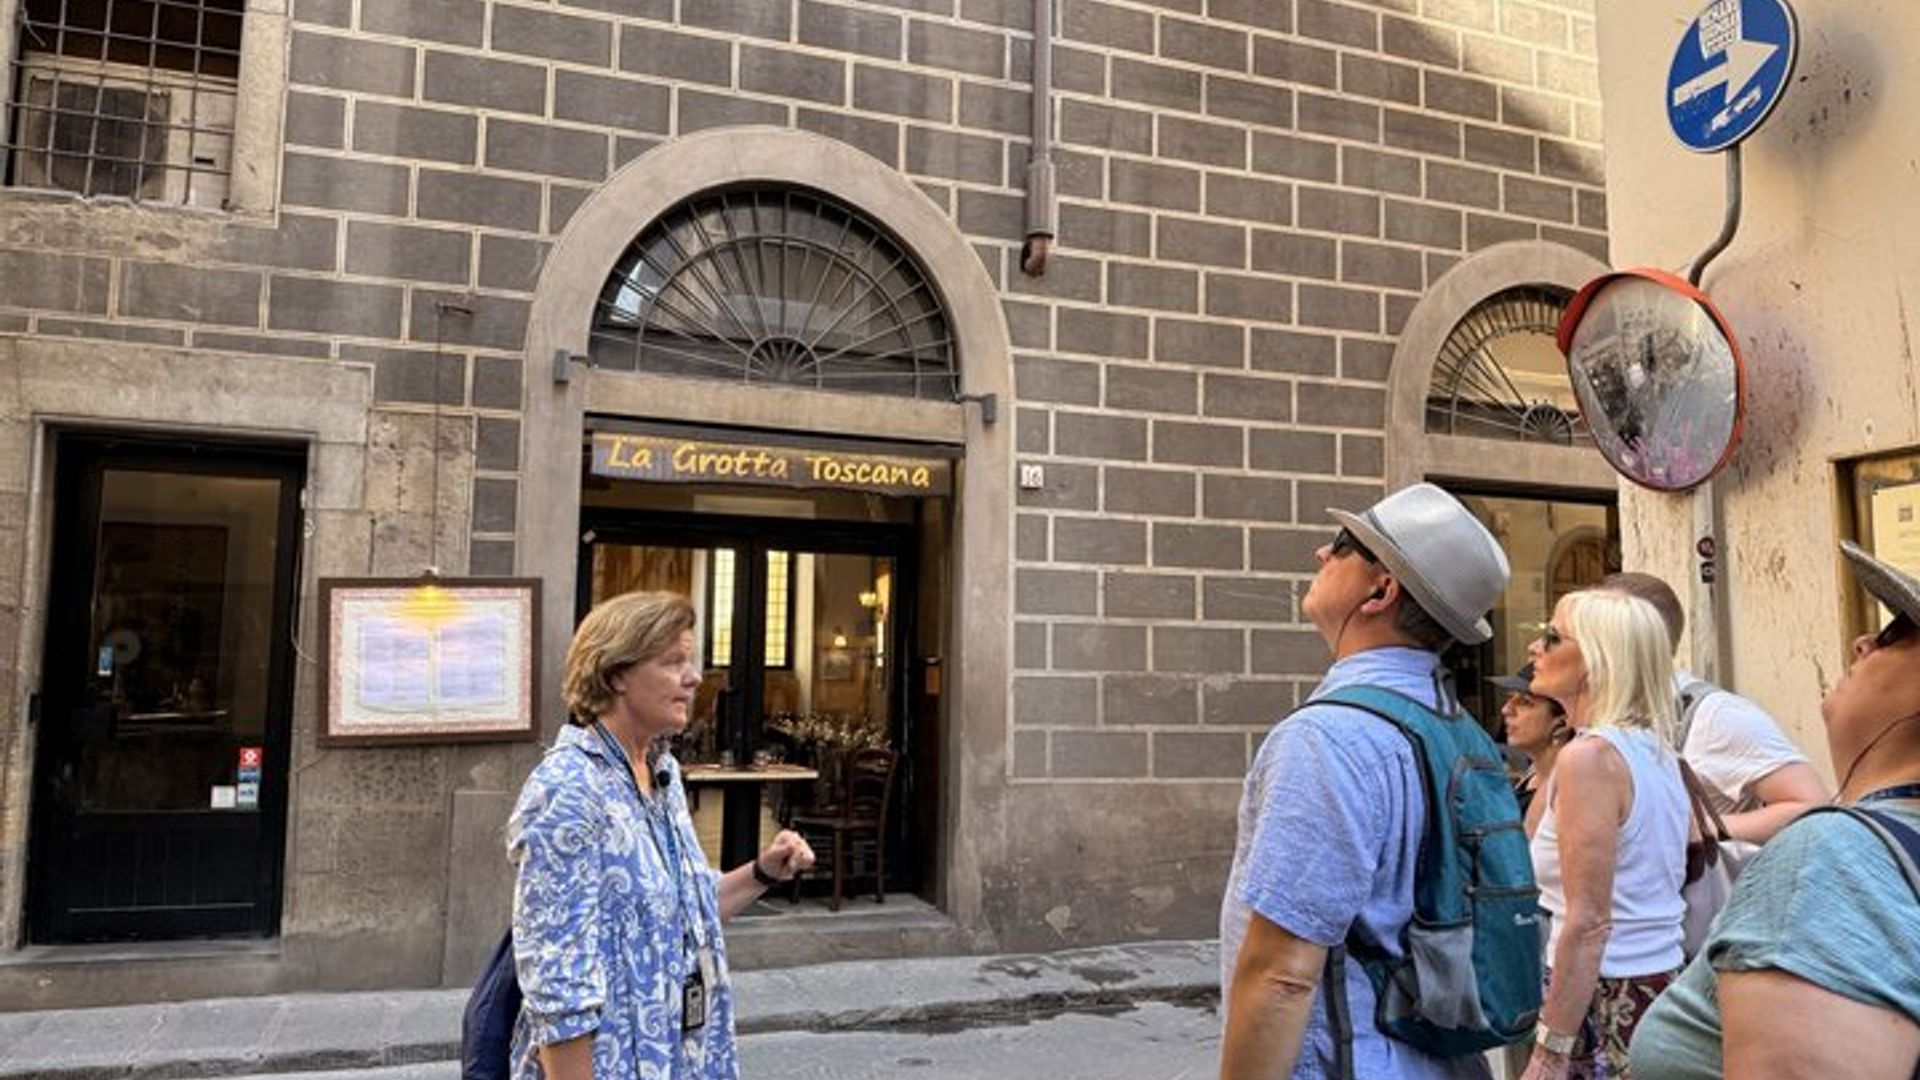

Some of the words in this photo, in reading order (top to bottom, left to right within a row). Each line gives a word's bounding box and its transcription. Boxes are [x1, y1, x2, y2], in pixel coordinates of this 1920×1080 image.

[608, 438, 652, 469] La
[672, 443, 789, 479] Grotta
[805, 456, 930, 488] Toscana
